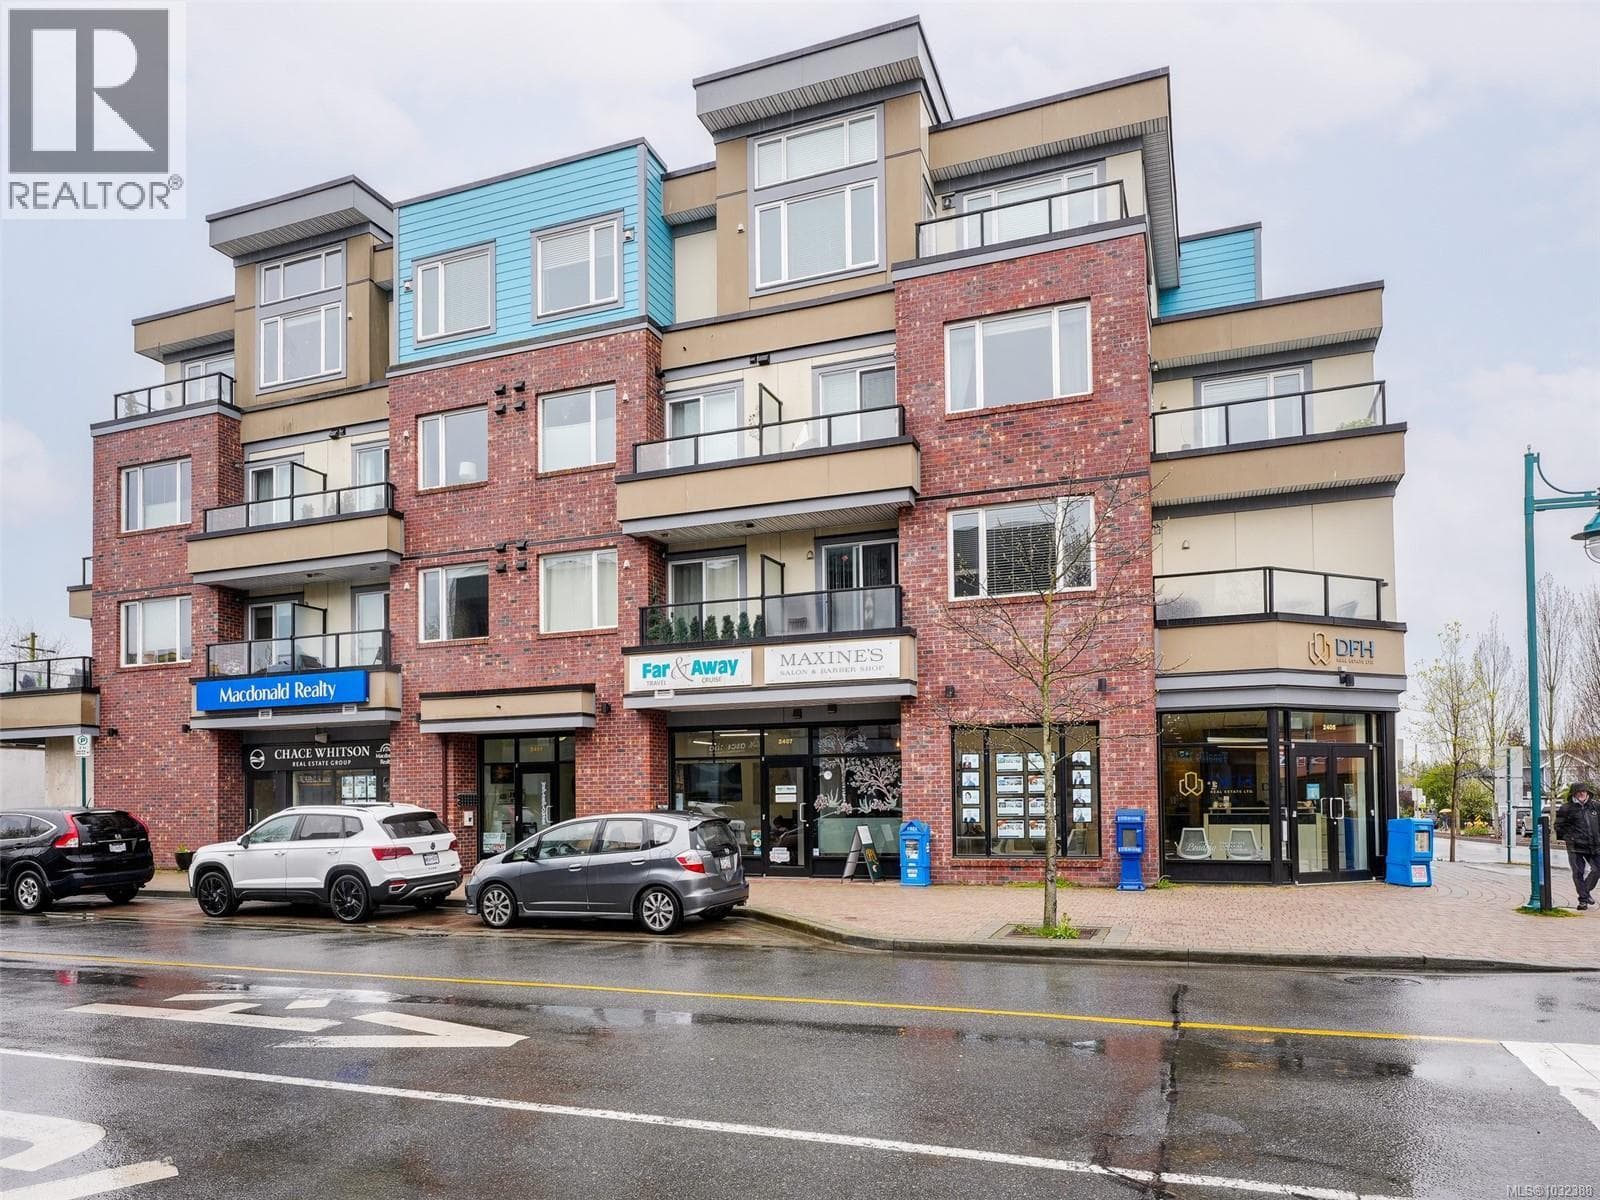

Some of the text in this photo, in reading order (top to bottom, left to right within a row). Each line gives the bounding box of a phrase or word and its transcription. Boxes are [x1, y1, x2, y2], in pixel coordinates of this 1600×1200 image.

[780, 648, 884, 667] MAXINE'S
[1335, 638, 1375, 659] DFH
[642, 656, 739, 682] Far & Away
[780, 668, 809, 676] SALON
[820, 666, 856, 674] BARBER
[219, 680, 336, 703] Macdonald Realty
[274, 745, 370, 760] CHACE WHITSON
